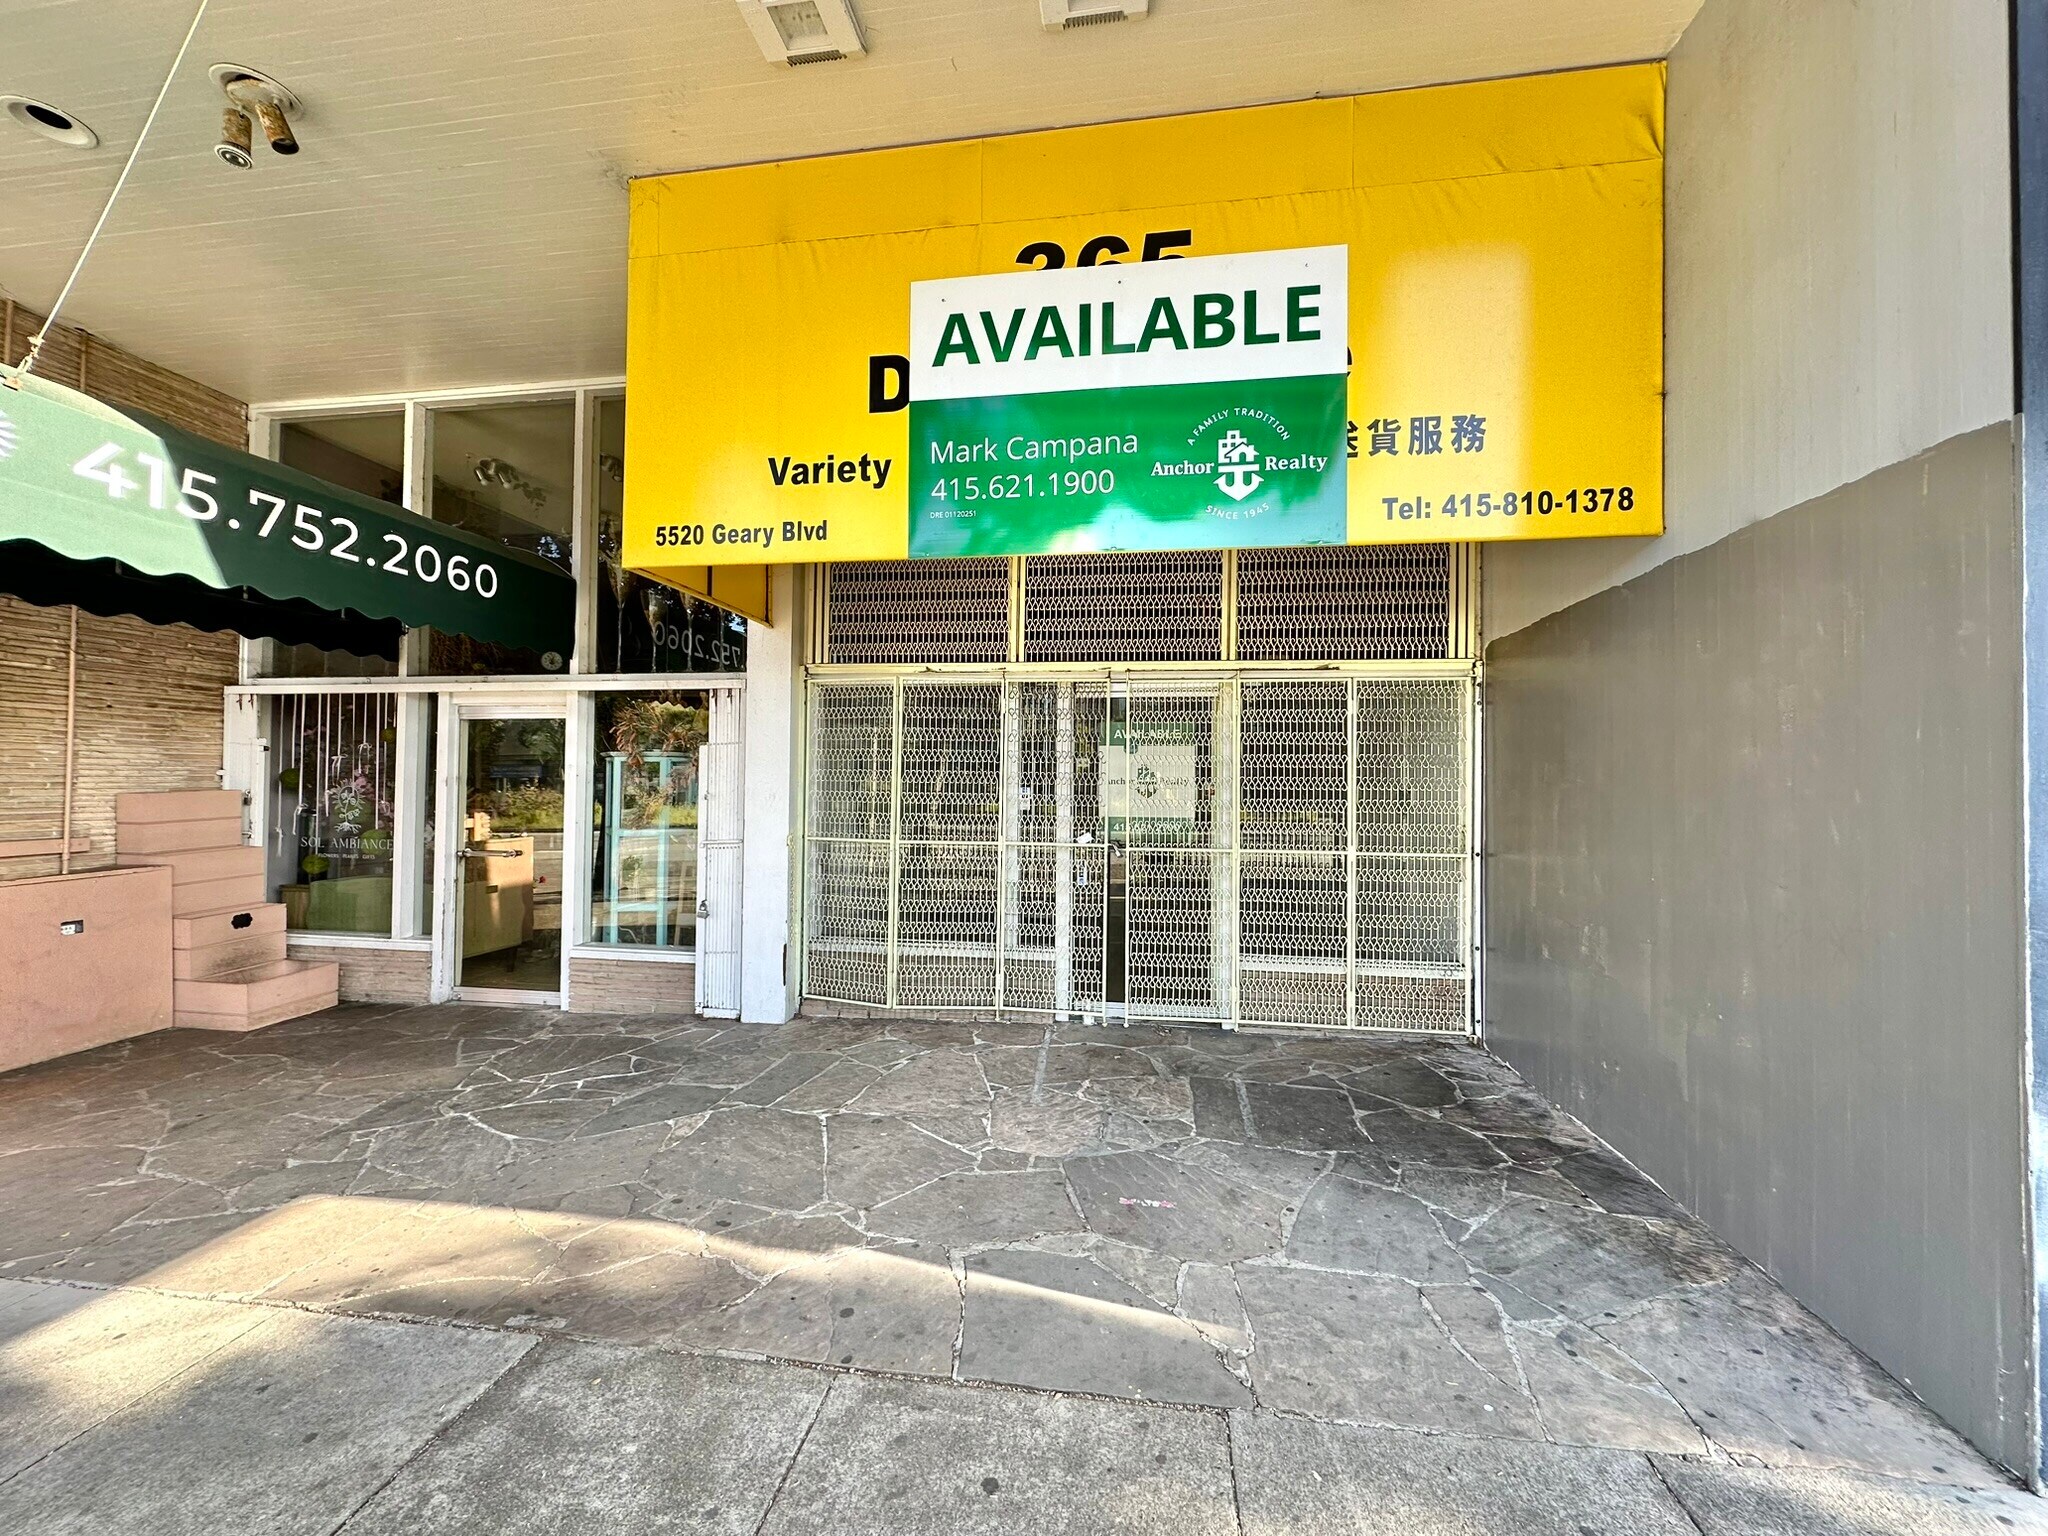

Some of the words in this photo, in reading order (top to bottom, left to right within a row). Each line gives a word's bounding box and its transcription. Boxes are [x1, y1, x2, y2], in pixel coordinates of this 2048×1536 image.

[932, 285, 1321, 367] AVAILABLE
[1187, 437, 1195, 446] A
[1193, 409, 1229, 436] FAMILY
[1234, 407, 1290, 441] TRADITION
[930, 437, 998, 464] Mark
[1006, 434, 1138, 463] Campana
[768, 452, 892, 488] Variety
[1150, 460, 1215, 477] Anchor
[1264, 453, 1328, 473] Realty
[930, 469, 1115, 501] 415.621.1900
[930, 511, 943, 519] DRE
[1205, 504, 1239, 520] SINCE
[1243, 502, 1270, 519] 1945
[1382, 496, 1433, 521] Tel:
[1441, 486, 1635, 518] 415-810-1378
[72, 440, 499, 599] 415.752.2060
[655, 525, 704, 547] 5520
[711, 524, 775, 548] Geary
[781, 520, 828, 542] Blvd
[300, 836, 325, 848] SOL
[331, 838, 394, 850] AMBIANCE
